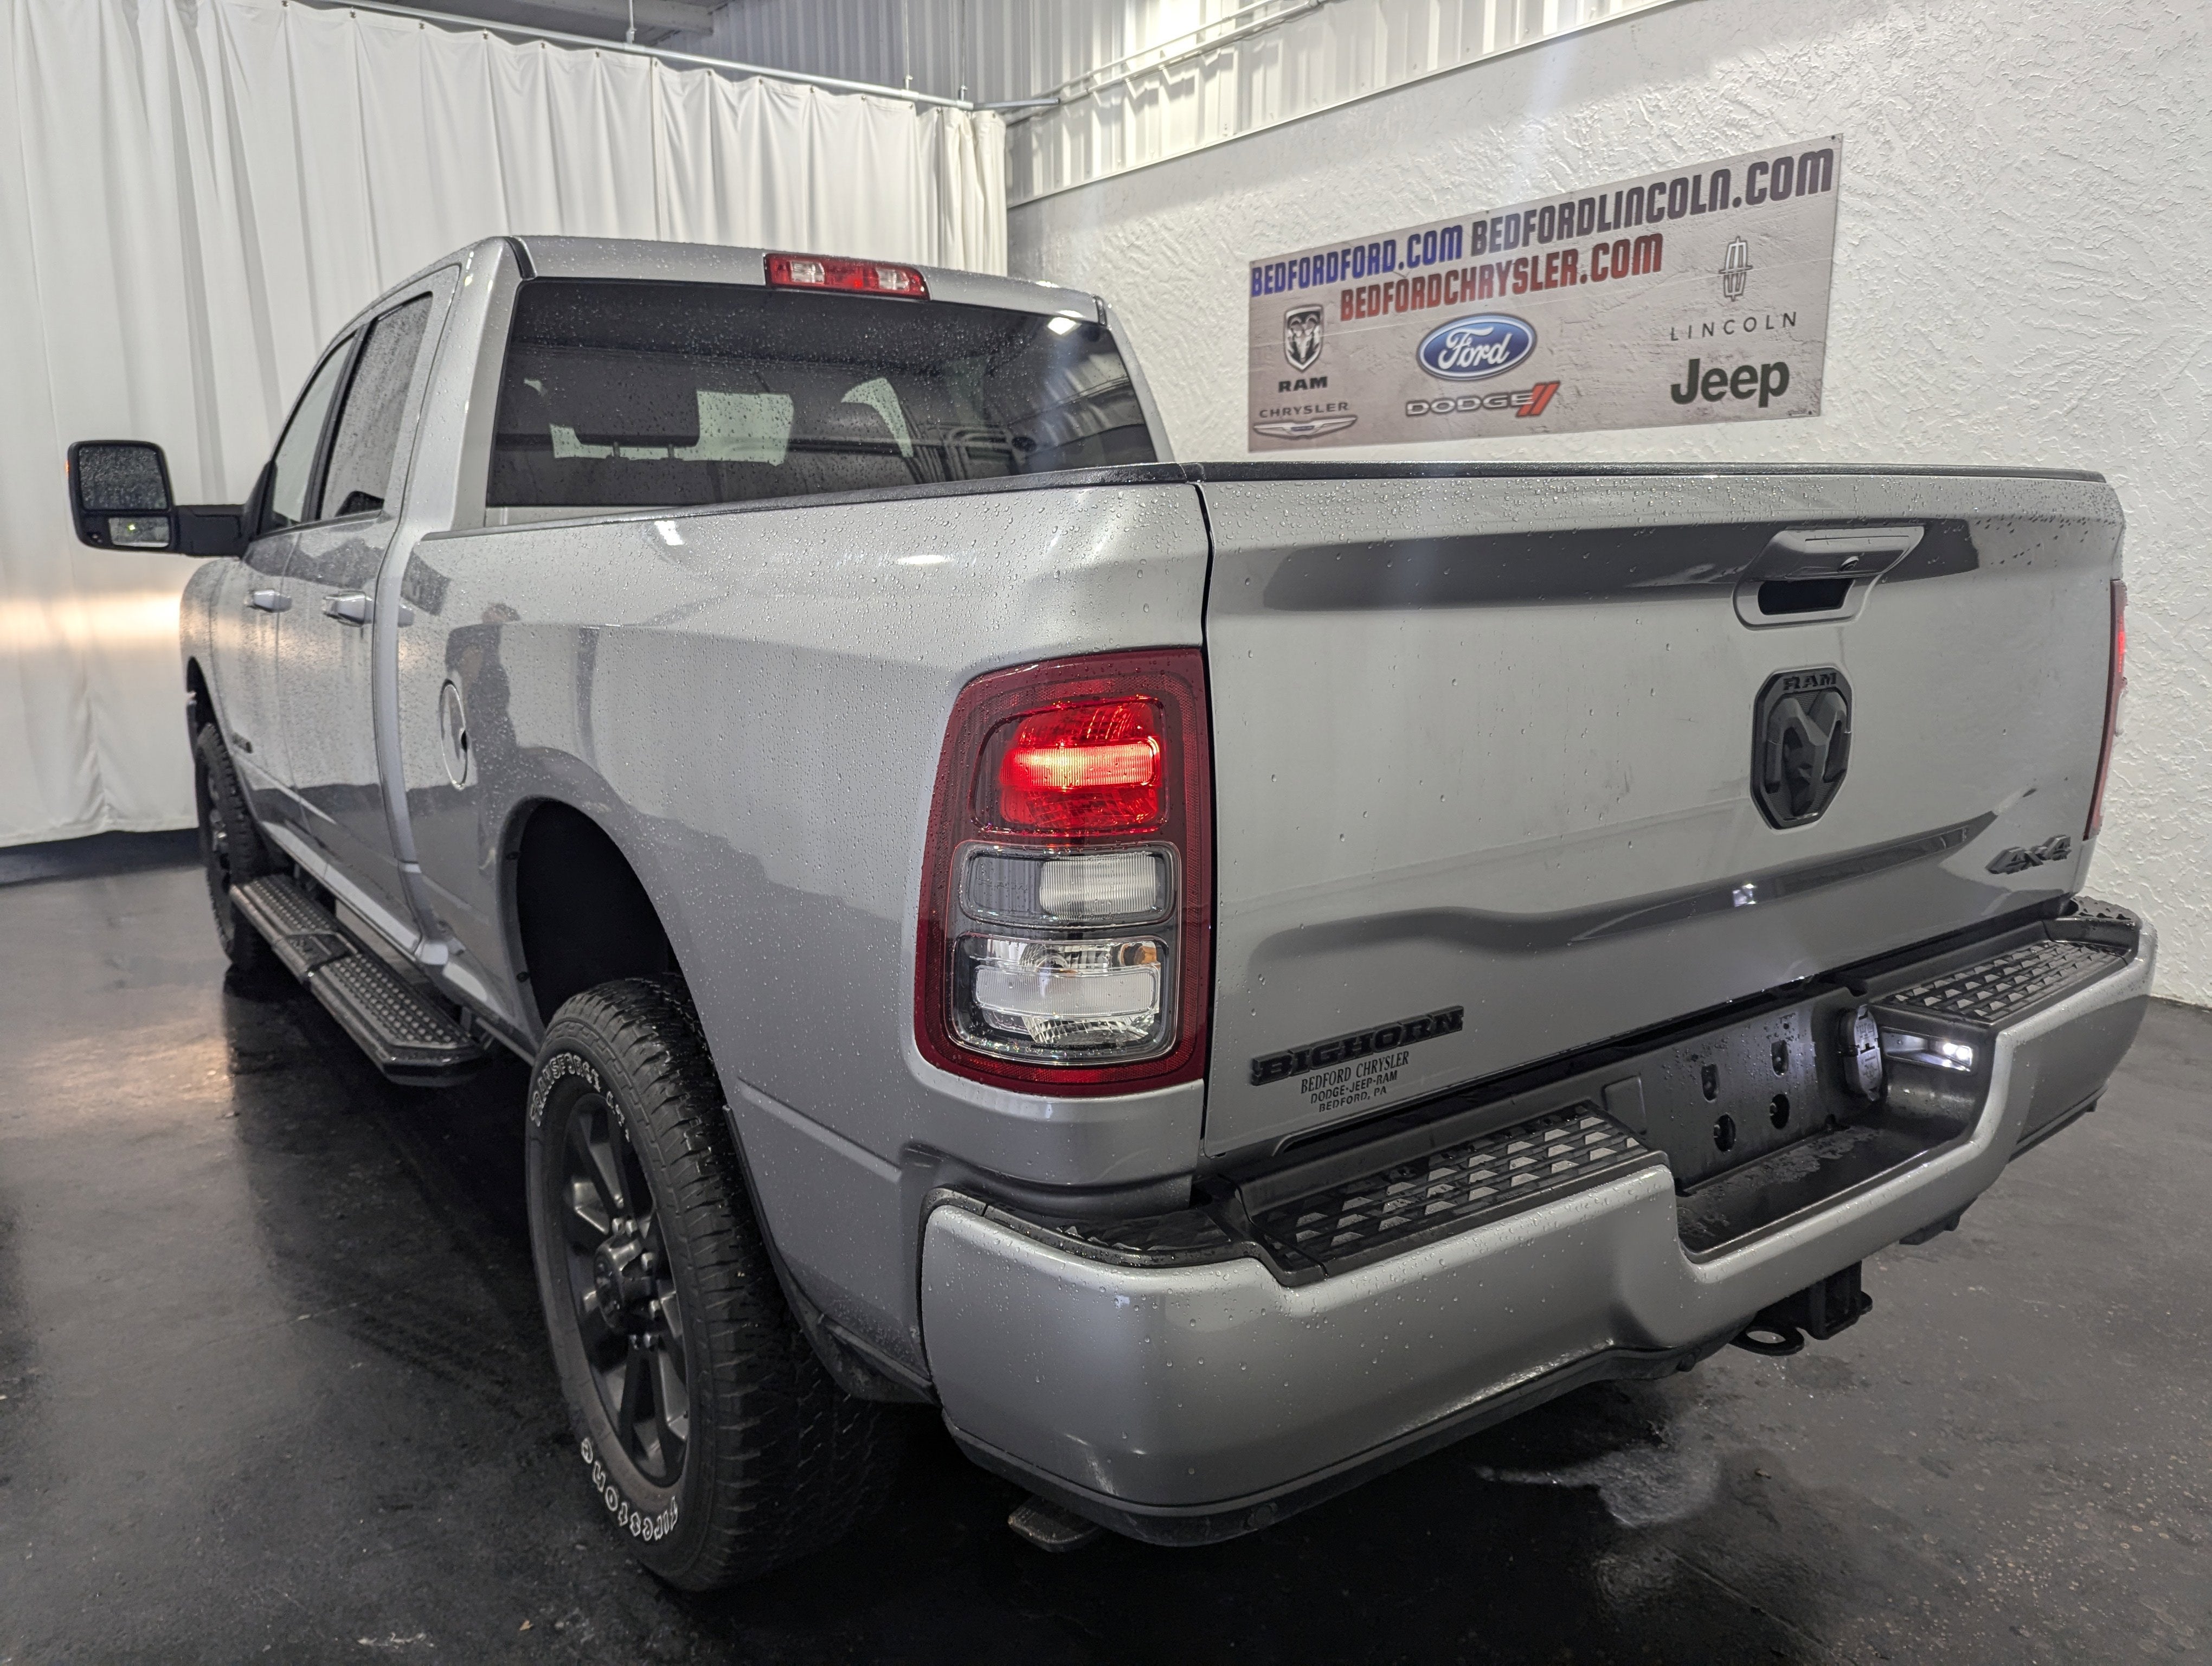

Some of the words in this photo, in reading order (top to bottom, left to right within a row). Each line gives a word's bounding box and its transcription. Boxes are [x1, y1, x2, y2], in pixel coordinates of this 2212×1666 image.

[1251, 224, 1463, 298] BEDFORDFORD.COM
[1470, 148, 1834, 257] BEDFORDLINCOLN.COM
[1340, 233, 1663, 322] BEDFORDCHRYSLER.COM
[1670, 311, 1797, 342] LINCOLN
[1437, 326, 1512, 369] Ford
[1278, 376, 1328, 393] RAM
[1670, 358, 1790, 408] Jeep
[1259, 401, 1349, 419] CHRYSLER
[1405, 389, 1536, 417] DODGE
[1783, 672, 1837, 690] RAM
[1301, 1067, 1352, 1094] BEDFORD
[1356, 1050, 1409, 1078] CHRYSLER
[1319, 1091, 1371, 1112] BEDFORD,
[1374, 1085, 1387, 1097] PA
